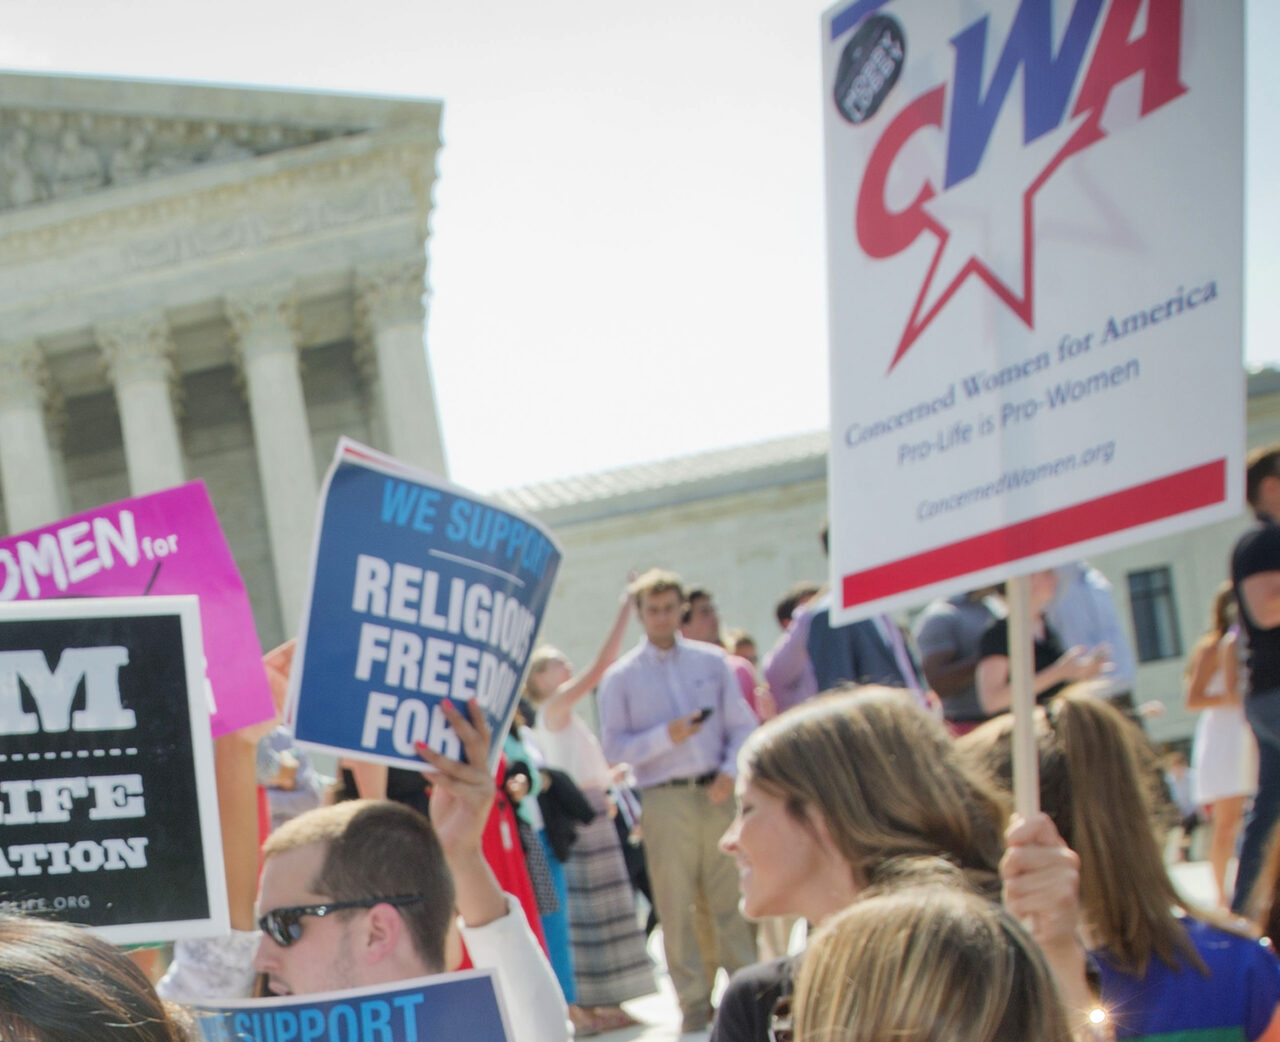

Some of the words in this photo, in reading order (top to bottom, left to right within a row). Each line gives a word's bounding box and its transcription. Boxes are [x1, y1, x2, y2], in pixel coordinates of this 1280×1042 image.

[854, 0, 1189, 261] CWA
[845, 385, 956, 449] Concerned
[963, 349, 1050, 398] Women
[1057, 331, 1094, 368] for
[1100, 280, 1218, 343] America
[897, 421, 973, 467] Pro-Life
[979, 413, 995, 436] is
[1001, 357, 1141, 430] Pro-Women
[381, 478, 441, 535] WE
[917, 438, 1116, 520] ConcernedWomen.org
[141, 534, 178, 560] for
[361, 691, 460, 762] FOR
